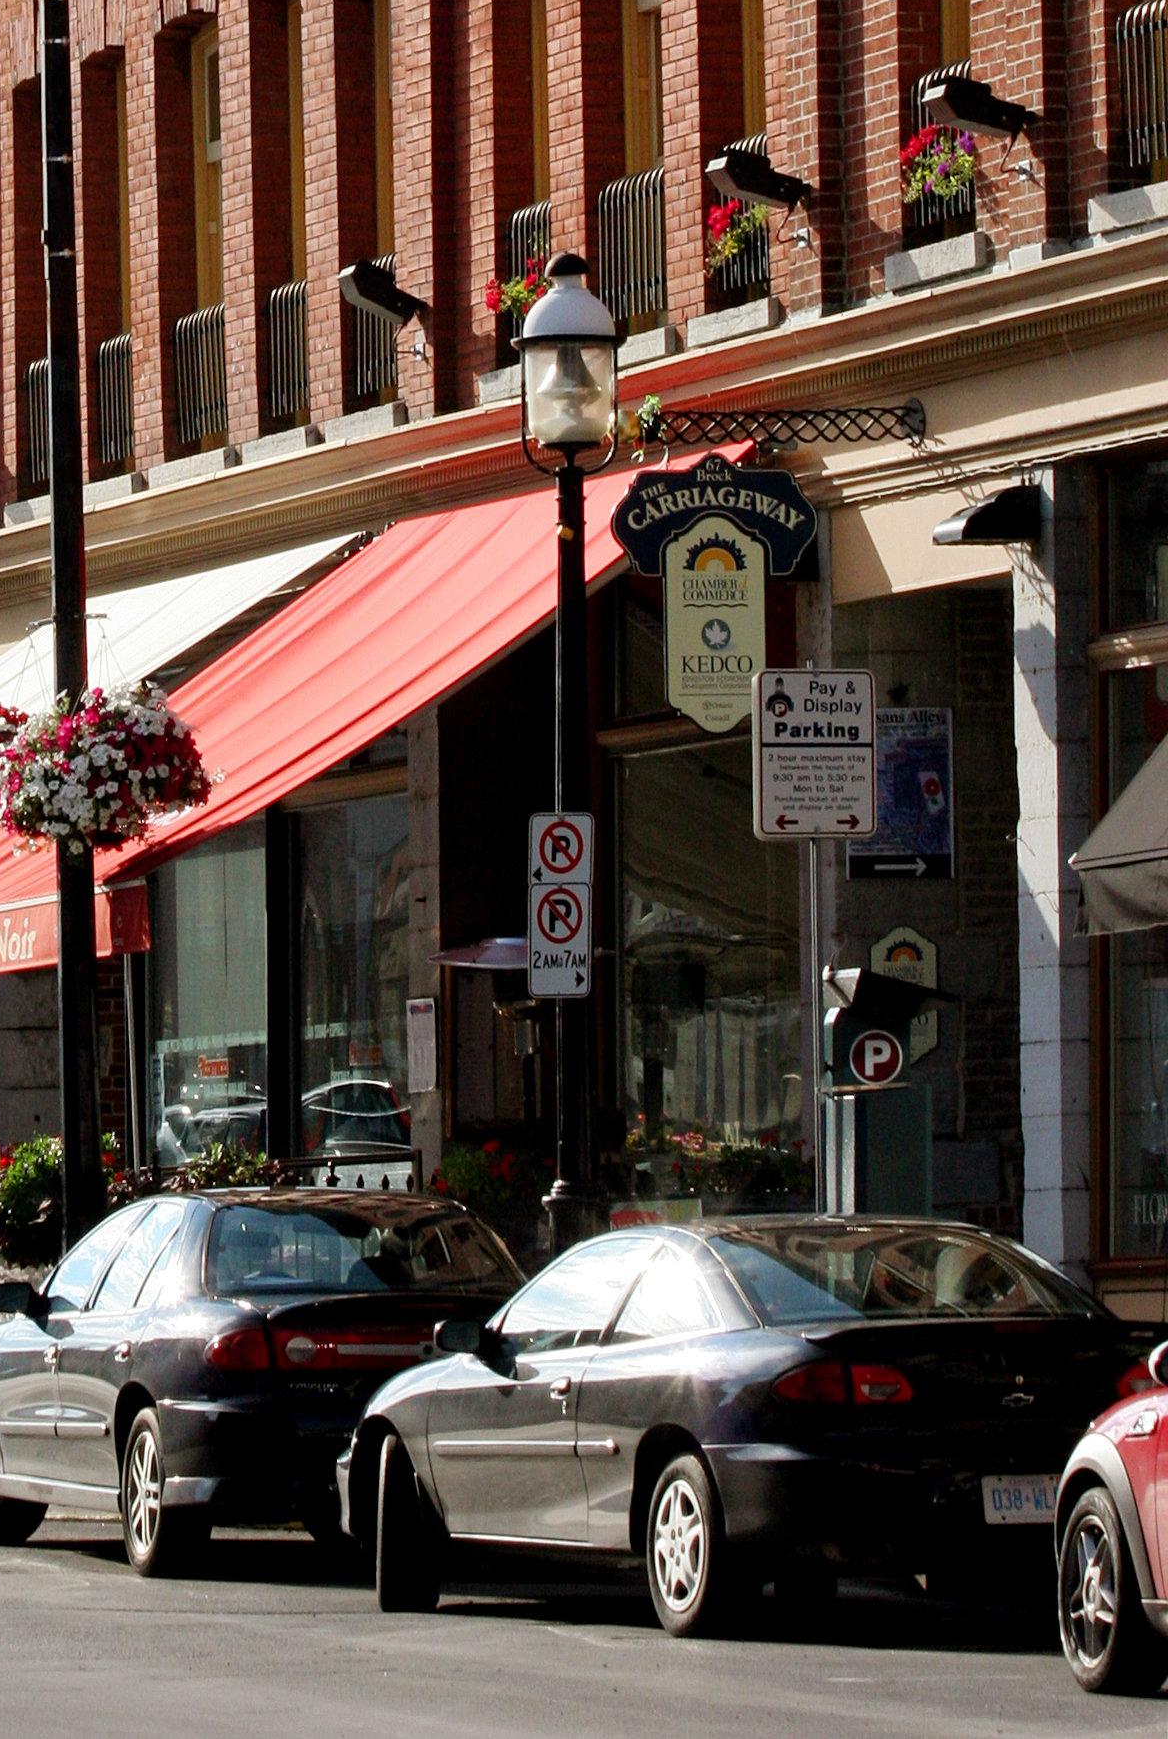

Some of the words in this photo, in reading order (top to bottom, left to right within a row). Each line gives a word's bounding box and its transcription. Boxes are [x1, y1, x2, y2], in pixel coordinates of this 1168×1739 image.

[705, 459, 721, 471] 67
[696, 469, 732, 482] Brock
[639, 482, 667, 500] THE
[627, 486, 807, 531] CARRIAGEWAY
[682, 579, 738, 590] CHAMBER
[682, 589, 748, 601] COMMERCE
[681, 655, 753, 674] KEDCO
[809, 681, 837, 697] Pay
[845, 681, 856, 694] &
[804, 699, 863, 715] Display
[774, 722, 860, 741] Parking
[768, 754, 774, 762] 2
[777, 754, 797, 762] hour
[801, 754, 844, 762] maximum
[847, 754, 866, 763] stay
[773, 774, 794, 782] 9:30
[814, 774, 823, 782] to
[827, 774, 848, 782] 5:30
[851, 775, 866, 783] pm
[793, 785, 812, 793] Mon
[816, 785, 825, 793] to
[829, 785, 844, 793] Sat
[864, 1039, 892, 1077] P
